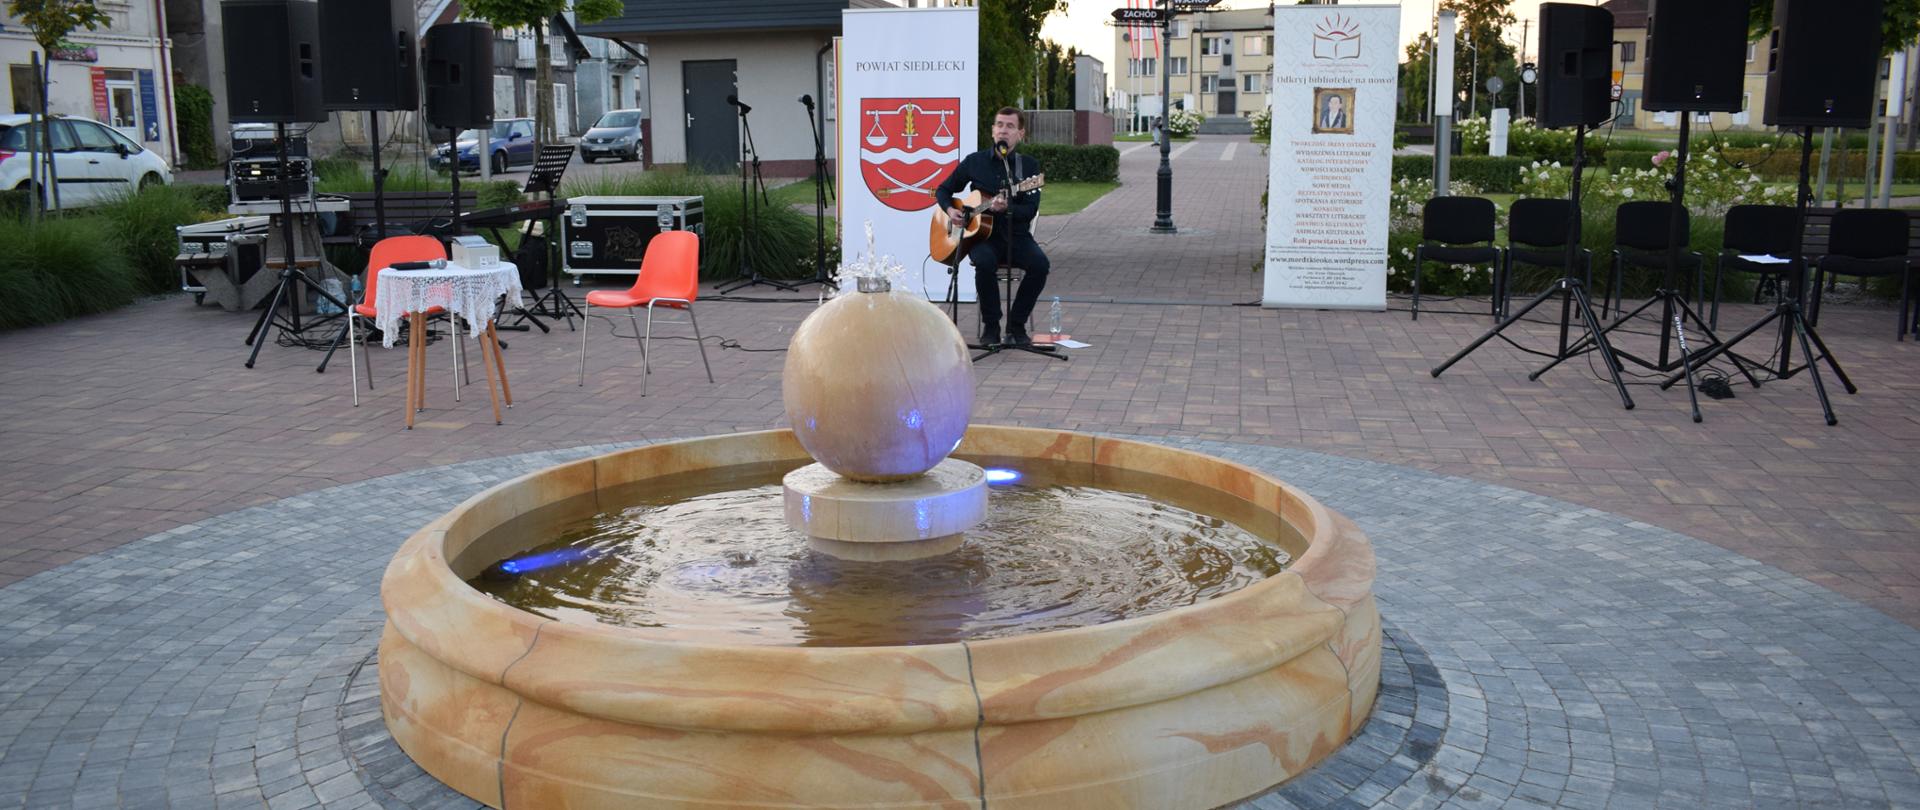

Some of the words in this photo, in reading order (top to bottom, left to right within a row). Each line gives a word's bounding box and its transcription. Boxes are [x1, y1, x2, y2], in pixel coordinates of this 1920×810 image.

[1124, 10, 1157, 18] ZACHÓD
[856, 61, 900, 72] POWIAT
[903, 61, 965, 72] SIEDLECKI
